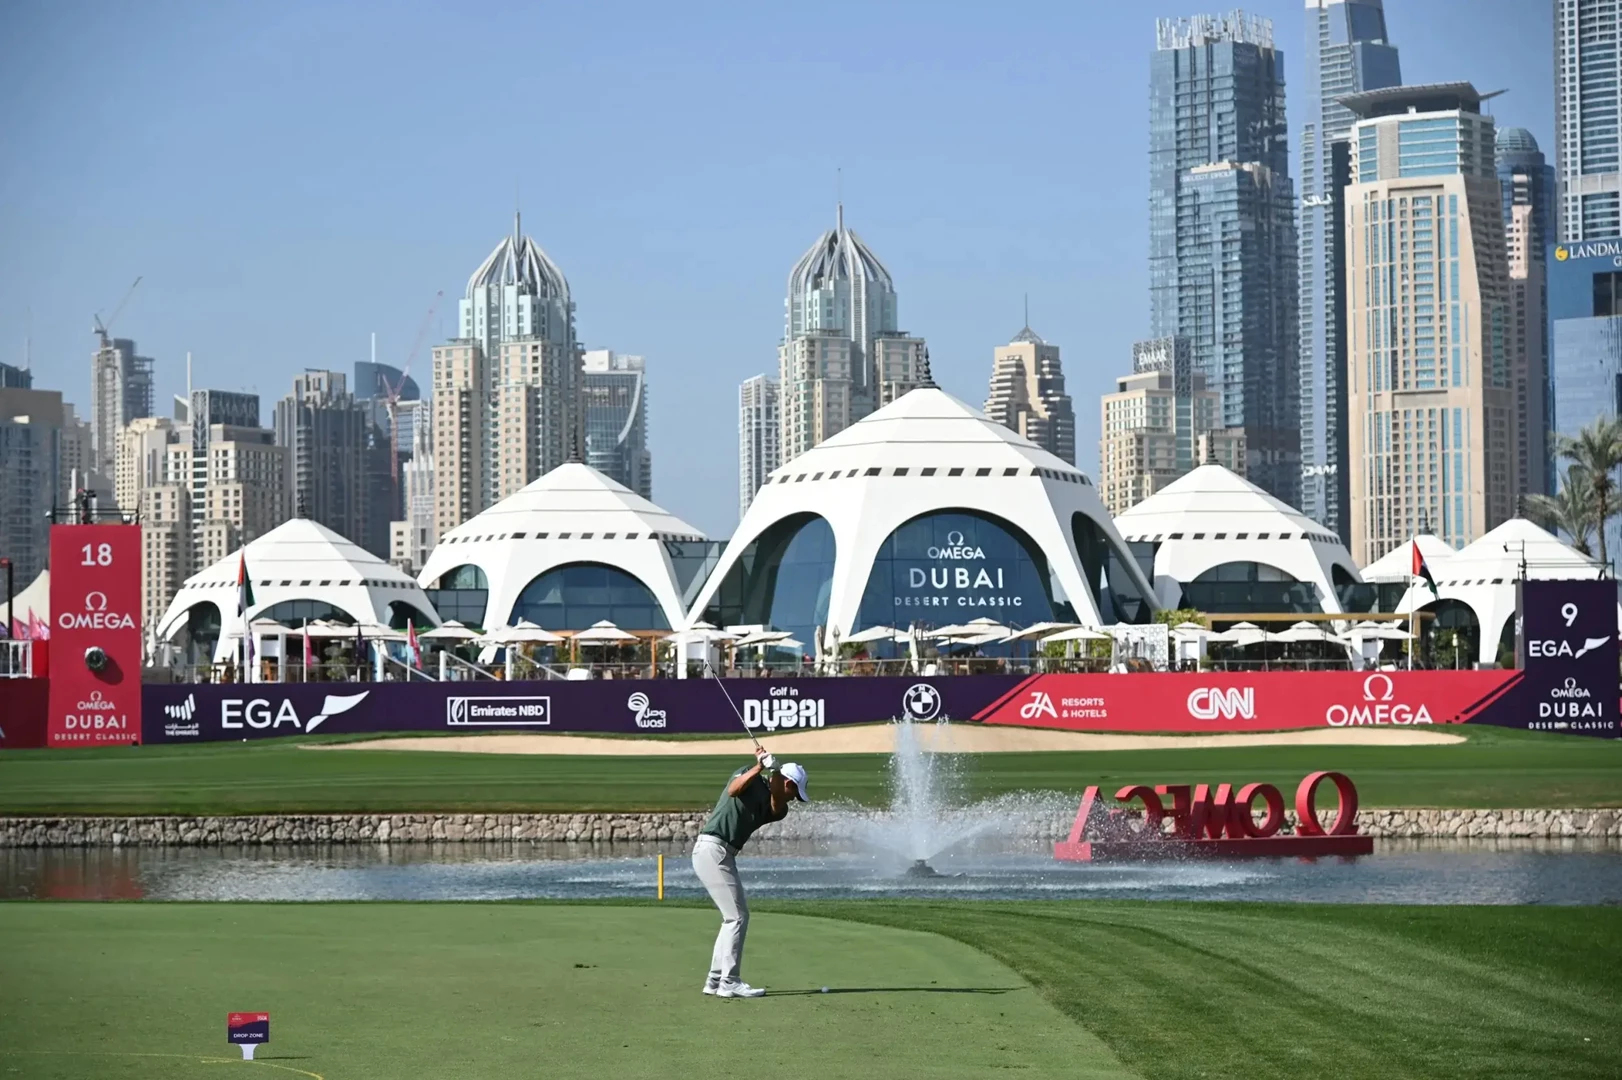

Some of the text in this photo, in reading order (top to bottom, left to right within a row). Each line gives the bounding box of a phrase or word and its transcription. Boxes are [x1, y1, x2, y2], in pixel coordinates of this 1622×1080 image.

[1570, 241, 1622, 259] LANDM
[1139, 348, 1167, 366] EMAAR
[81, 543, 112, 566] 18
[928, 547, 986, 560] OMEGA
[909, 567, 1004, 589] DUBAI
[894, 596, 1022, 607] DESERT CLASSIC
[59, 612, 135, 629] OMEGA
[1561, 602, 1578, 627] 9
[1529, 640, 1573, 657] EGA
[769, 686, 799, 697] Golf in
[1551, 688, 1591, 698] OMEGA
[77, 700, 116, 710] OMEGA
[1061, 698, 1104, 708] RESORTS
[1187, 687, 1255, 720] CNN
[1539, 702, 1602, 718] DUBAI
[221, 698, 301, 729] EGA
[470, 705, 544, 717] Emirates NBD
[743, 698, 825, 731] DUBAI
[1062, 709, 1107, 718] & HOTELS
[1326, 704, 1433, 727] OMEGA
[65, 714, 126, 729] DUBAI
[640, 717, 667, 728] wasl
[1528, 721, 1614, 730] DESER CLASSIC
[54, 733, 137, 741] DESERT CLASSIC
